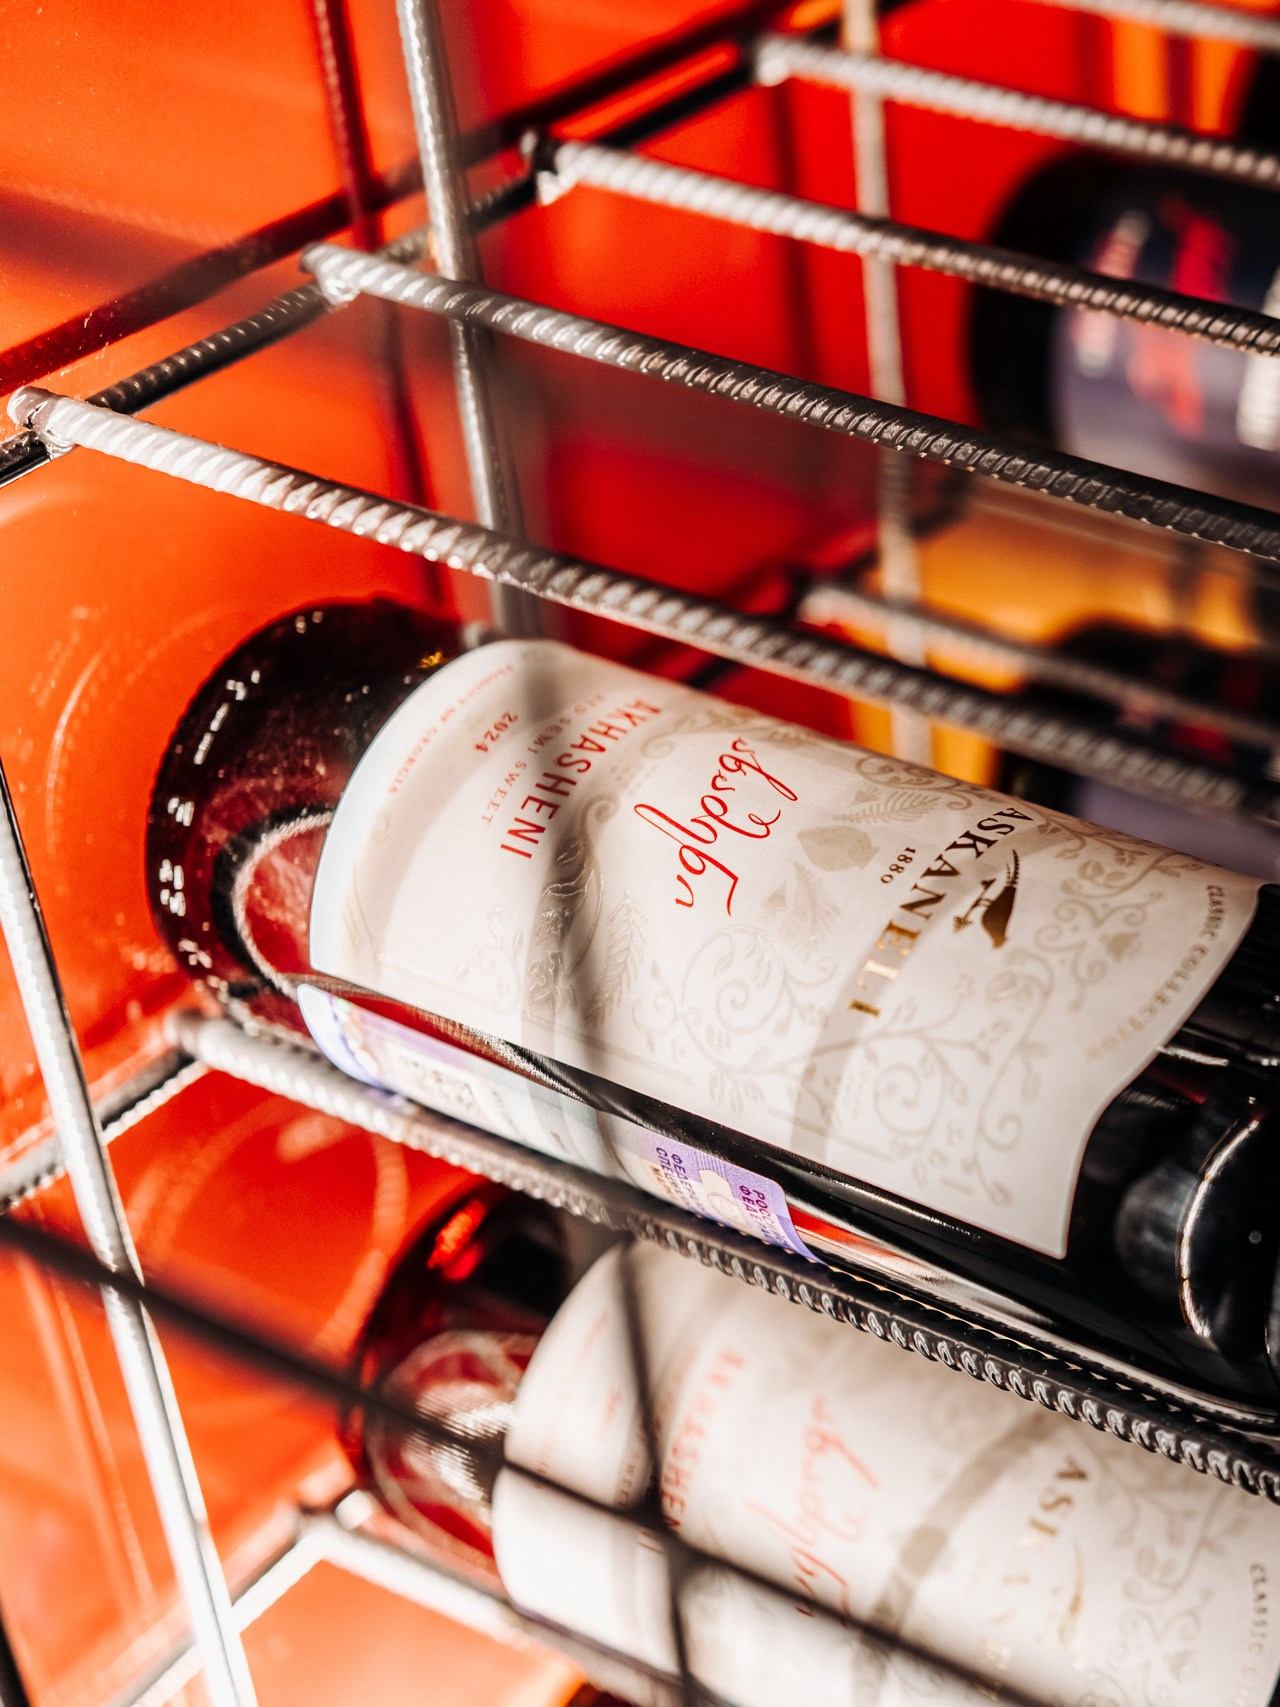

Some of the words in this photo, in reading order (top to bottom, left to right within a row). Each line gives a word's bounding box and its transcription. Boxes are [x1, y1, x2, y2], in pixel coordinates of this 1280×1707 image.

[474, 710, 519, 753] 2024
[481, 760, 527, 826] SWEET
[500, 699, 662, 860] AKHASHENI
[880, 846, 917, 885] 1880
[849, 807, 1035, 1018] ASKANELI
